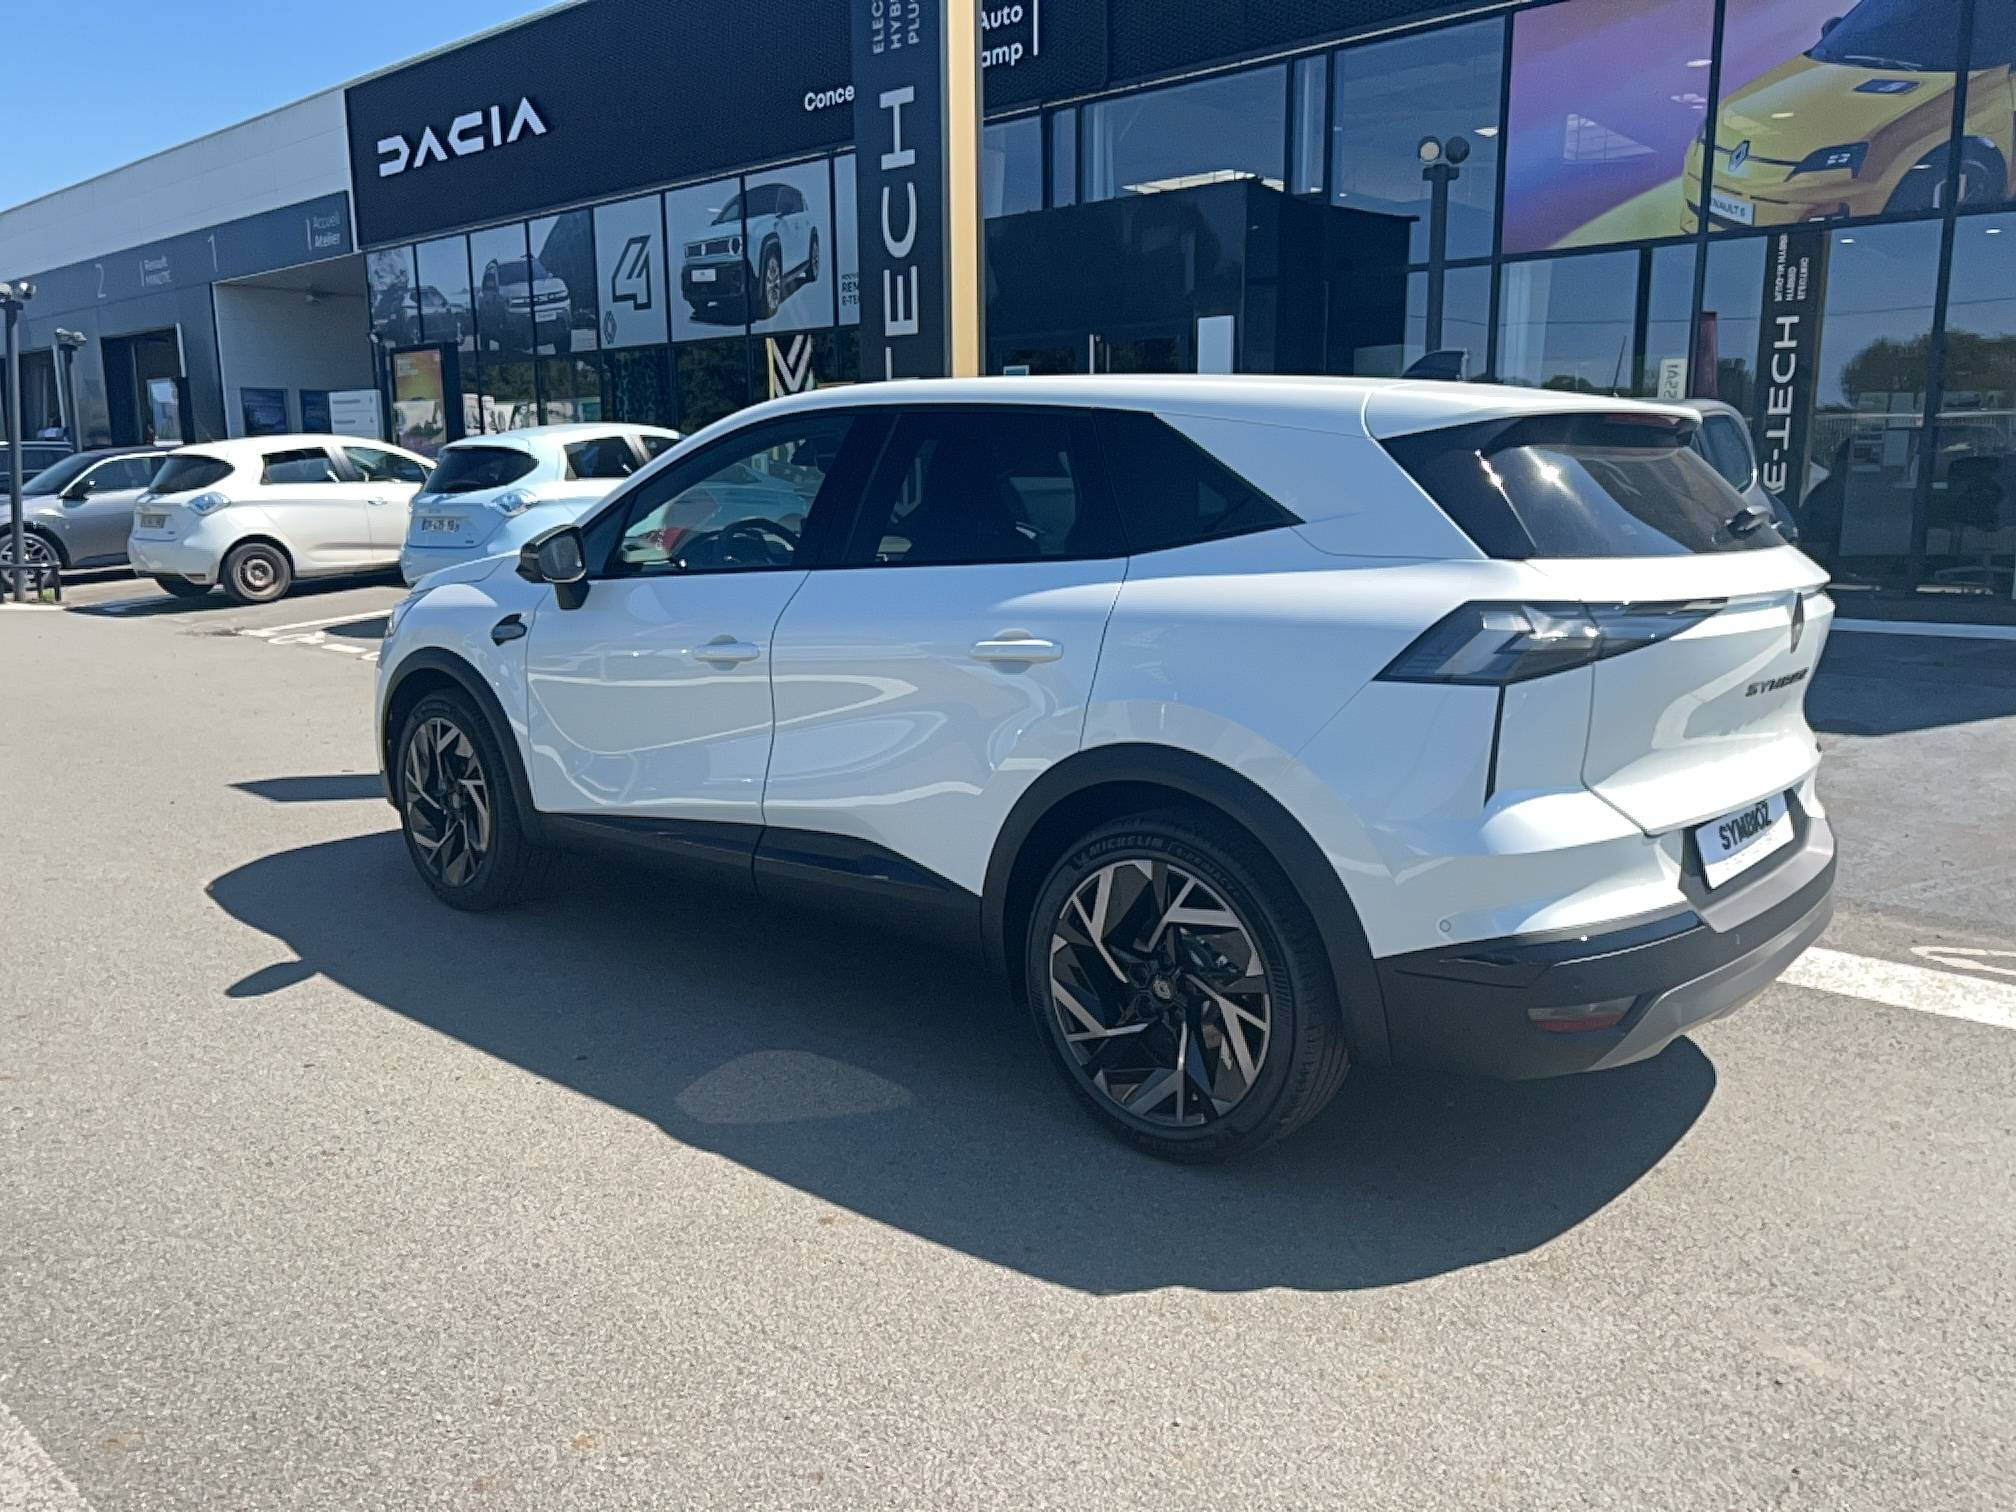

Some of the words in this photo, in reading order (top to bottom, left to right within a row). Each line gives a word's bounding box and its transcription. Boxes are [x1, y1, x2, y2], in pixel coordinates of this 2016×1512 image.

[890, 0, 902, 49] HYB
[908, 0, 920, 44] PLU
[981, 5, 1024, 31] Auto
[981, 42, 1023, 68] amp
[804, 85, 855, 111] Conce
[377, 96, 547, 177] DACIA
[208, 234, 219, 273] 1
